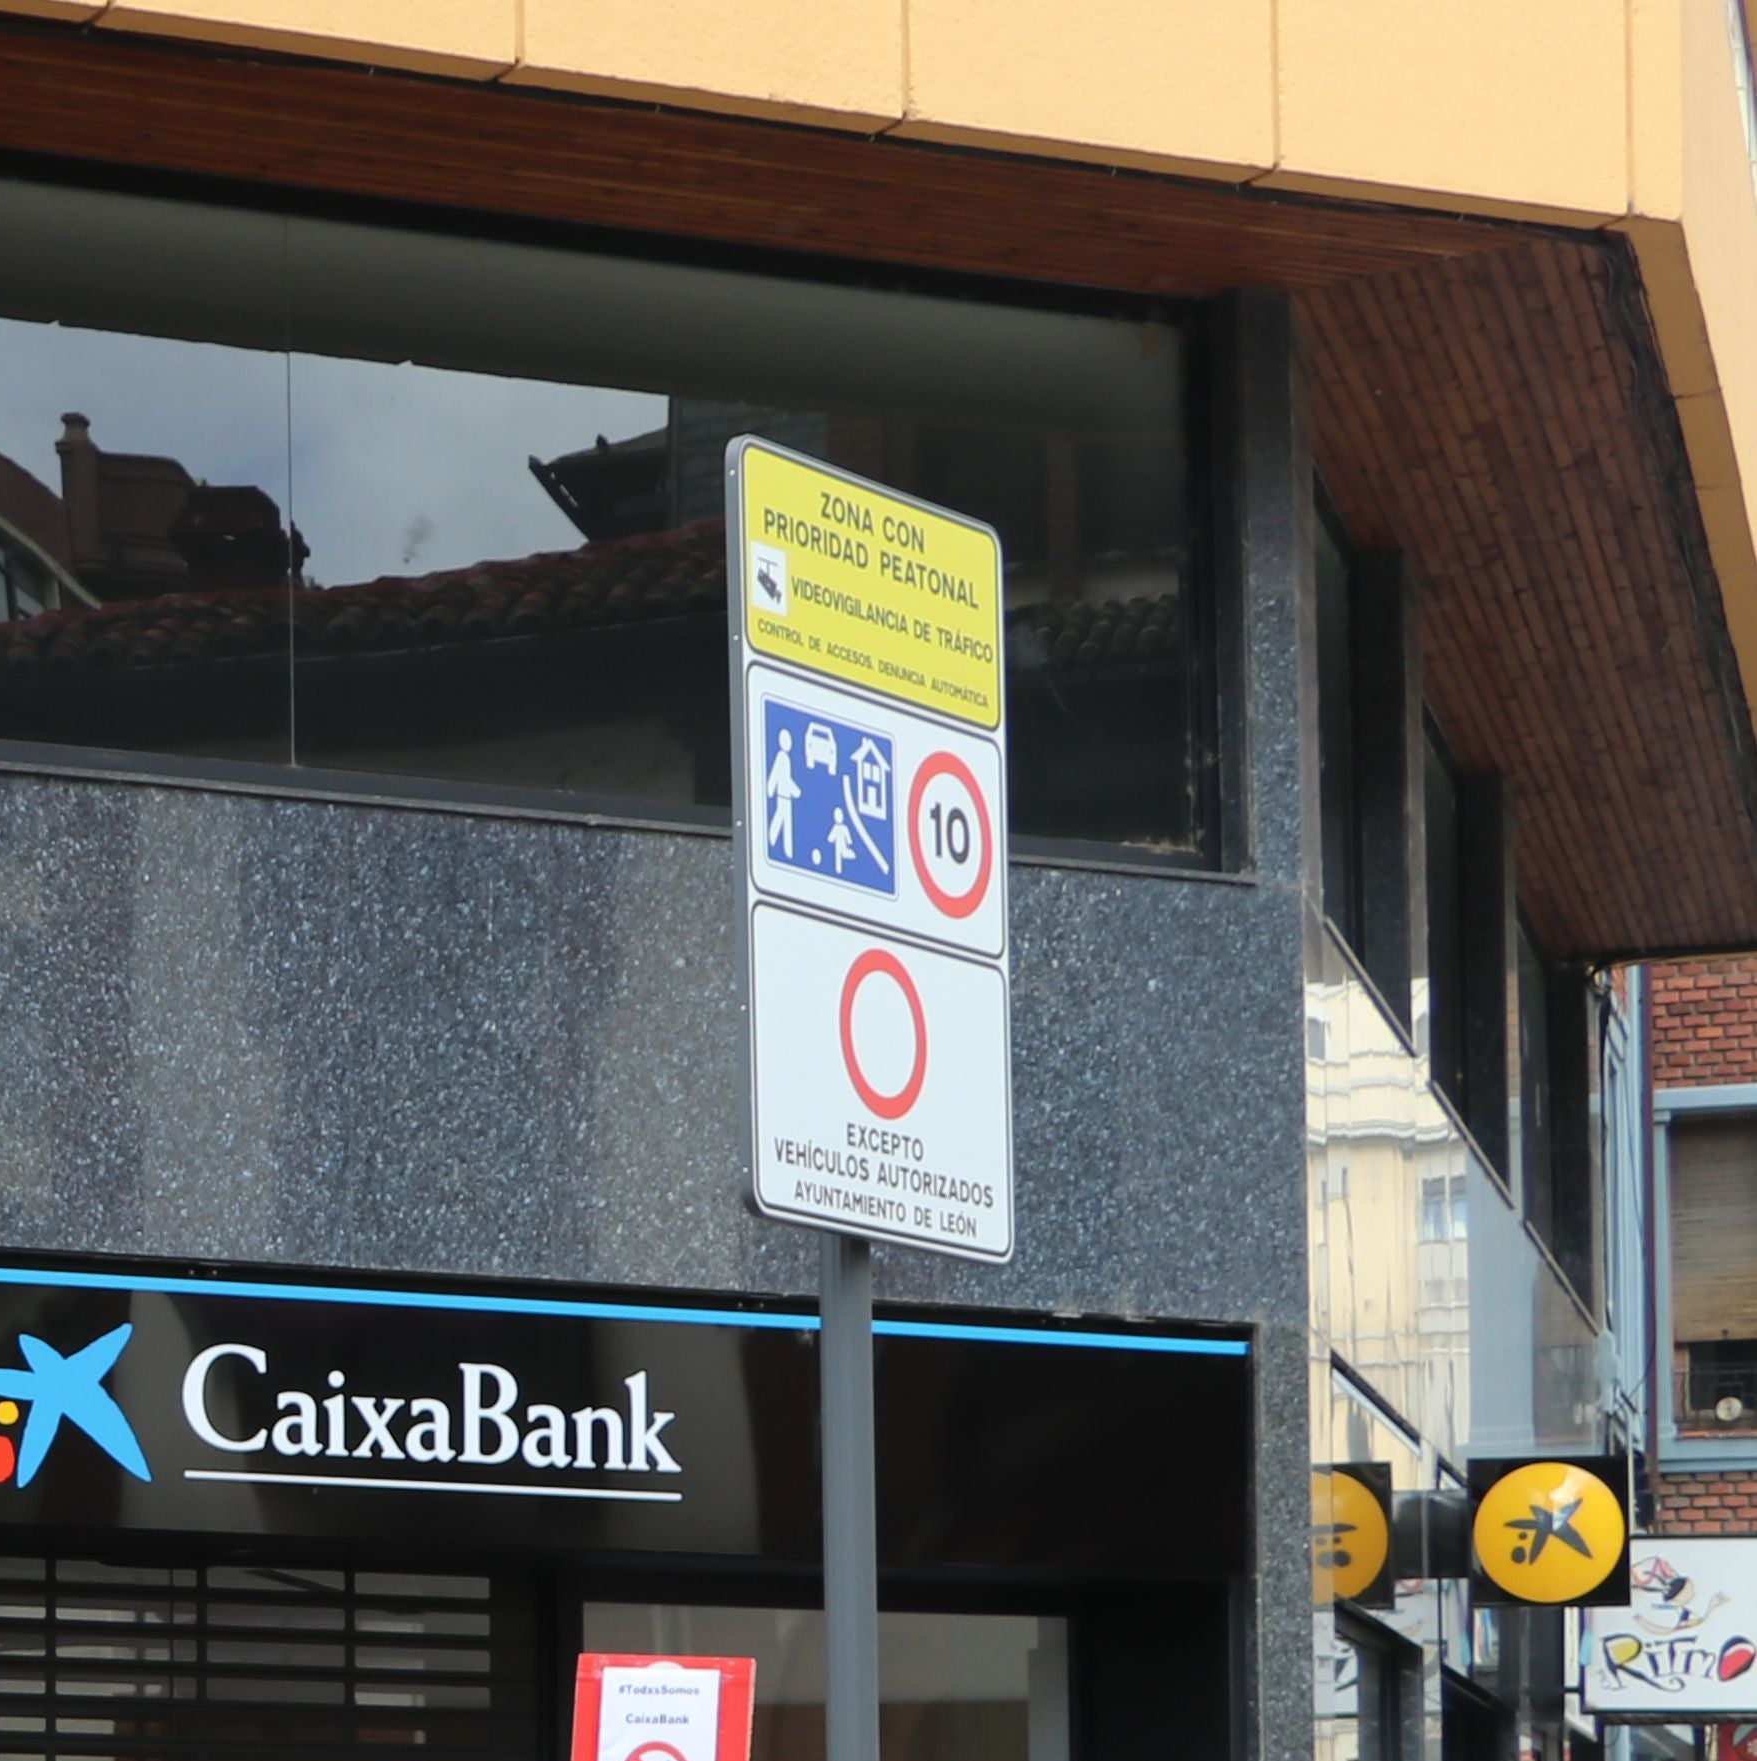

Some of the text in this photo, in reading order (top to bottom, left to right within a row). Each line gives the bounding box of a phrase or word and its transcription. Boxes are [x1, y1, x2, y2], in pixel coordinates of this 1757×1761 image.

[820, 492, 926, 555] ZONA CON
[763, 508, 980, 610] PRIORIDAD PEATONAL
[791, 575, 994, 664] VIDEOVIGILANCIA DE TRÁFICO
[757, 618, 804, 647] CONTROL
[808, 634, 822, 653] DE
[878, 658, 927, 689] DENUNCIA
[930, 802, 971, 865] 10
[774, 1137, 994, 1209] VEHÍCULOS AUTORIZADOS
[847, 1123, 924, 1163] EXCEPTO
[794, 1180, 977, 1239] AYUNTAMIENTO DE LEÓN
[182, 1343, 683, 1475] CaixaBank
[625, 1713, 690, 1725] CaixaBank
